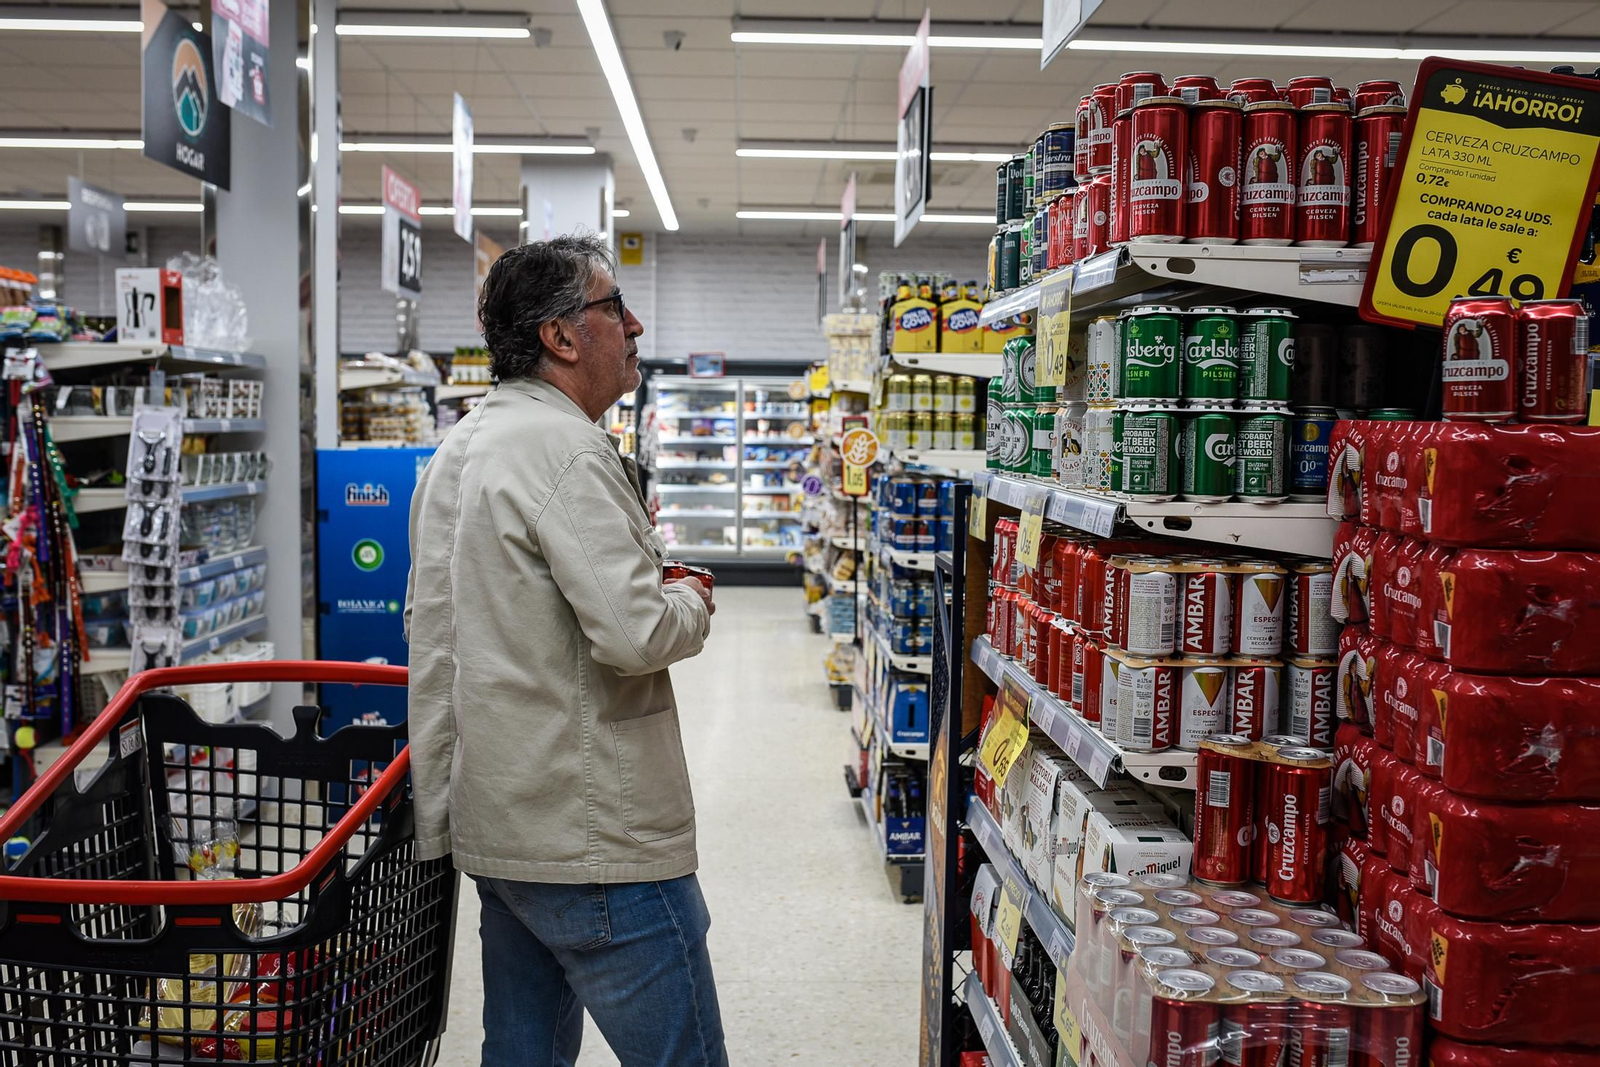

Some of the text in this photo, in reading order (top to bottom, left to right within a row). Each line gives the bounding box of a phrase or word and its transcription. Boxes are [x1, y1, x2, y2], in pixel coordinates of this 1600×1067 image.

[1472, 90, 1583, 124] ¡AHORRO!
[1478, 83, 1501, 92] PRECIO
[1506, 88, 1529, 96] PRECIO
[1533, 92, 1556, 100] PRECIO
[176, 142, 205, 171] HOGAR
[1421, 146, 1493, 167] LATA 330 ML
[1425, 130, 1581, 166] CERVEZA CRUZCAMPO
[1354, 141, 1370, 225] Cruzcampo
[1418, 162, 1464, 177] Comprando
[1469, 169, 1497, 182] unidad
[1419, 193, 1553, 226] COMPRANDO 24 UDS.
[1427, 209, 1539, 238] cada lata le sale a:
[1506, 248, 1522, 264] €
[1522, 323, 1541, 408] Cruzcampo
[1131, 438, 1156, 446] BEER
[1248, 441, 1273, 449] BEER
[347, 483, 389, 501] finish
[1375, 471, 1408, 491] Cruzcampo
[1103, 567, 1115, 640] AMBAR
[1186, 574, 1206, 650] AMBAR
[1287, 574, 1299, 649] AMBAR
[1384, 583, 1422, 610] Cruzcampo
[1155, 671, 1171, 743] AMBAR
[1235, 669, 1256, 740] AMBAR
[1313, 671, 1332, 744] AMBAR
[1031, 759, 1053, 785] VICTORIA
[1278, 793, 1300, 881] Cruzcampo
